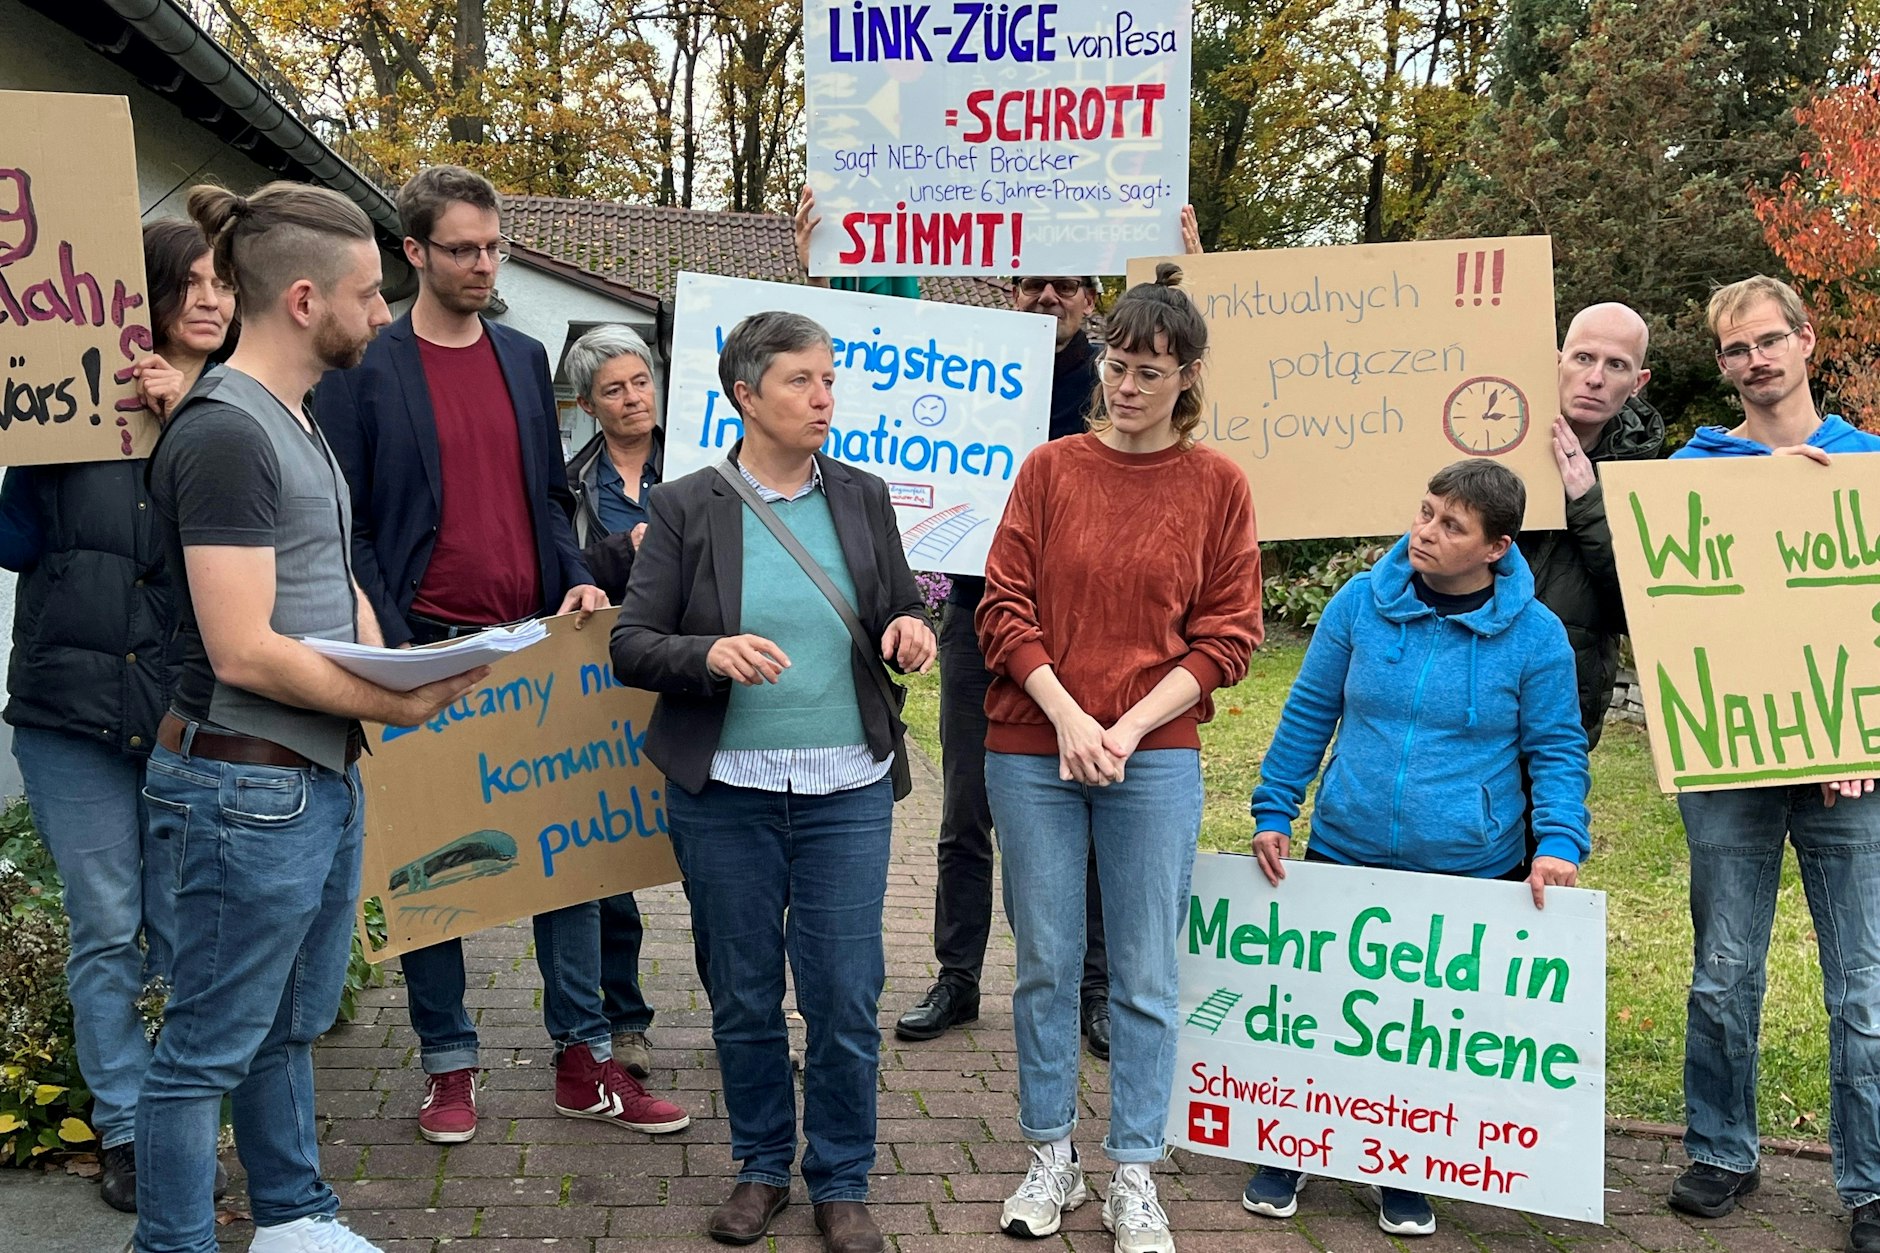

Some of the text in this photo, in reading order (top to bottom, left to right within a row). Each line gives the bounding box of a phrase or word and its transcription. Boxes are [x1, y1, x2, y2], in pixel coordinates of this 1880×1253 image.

[888, 143, 979, 173] NEB-Chef
[990, 146, 1079, 173] Bröcker
[1191, 271, 1420, 324] unktualnych
[0, 346, 101, 431] ärs!
[715, 325, 1023, 400] enigstens
[1269, 340, 1465, 400] połączeń
[1190, 396, 1404, 460] olejowych
[1629, 489, 1880, 581] Wir woll
[1188, 895, 1570, 1004] Mehr Geld in
[1244, 984, 1580, 1090] die Schiene
[1188, 1062, 1539, 1150] Schweiz investiert pro
[1257, 1118, 1528, 1194] Kopf 3x mehr
